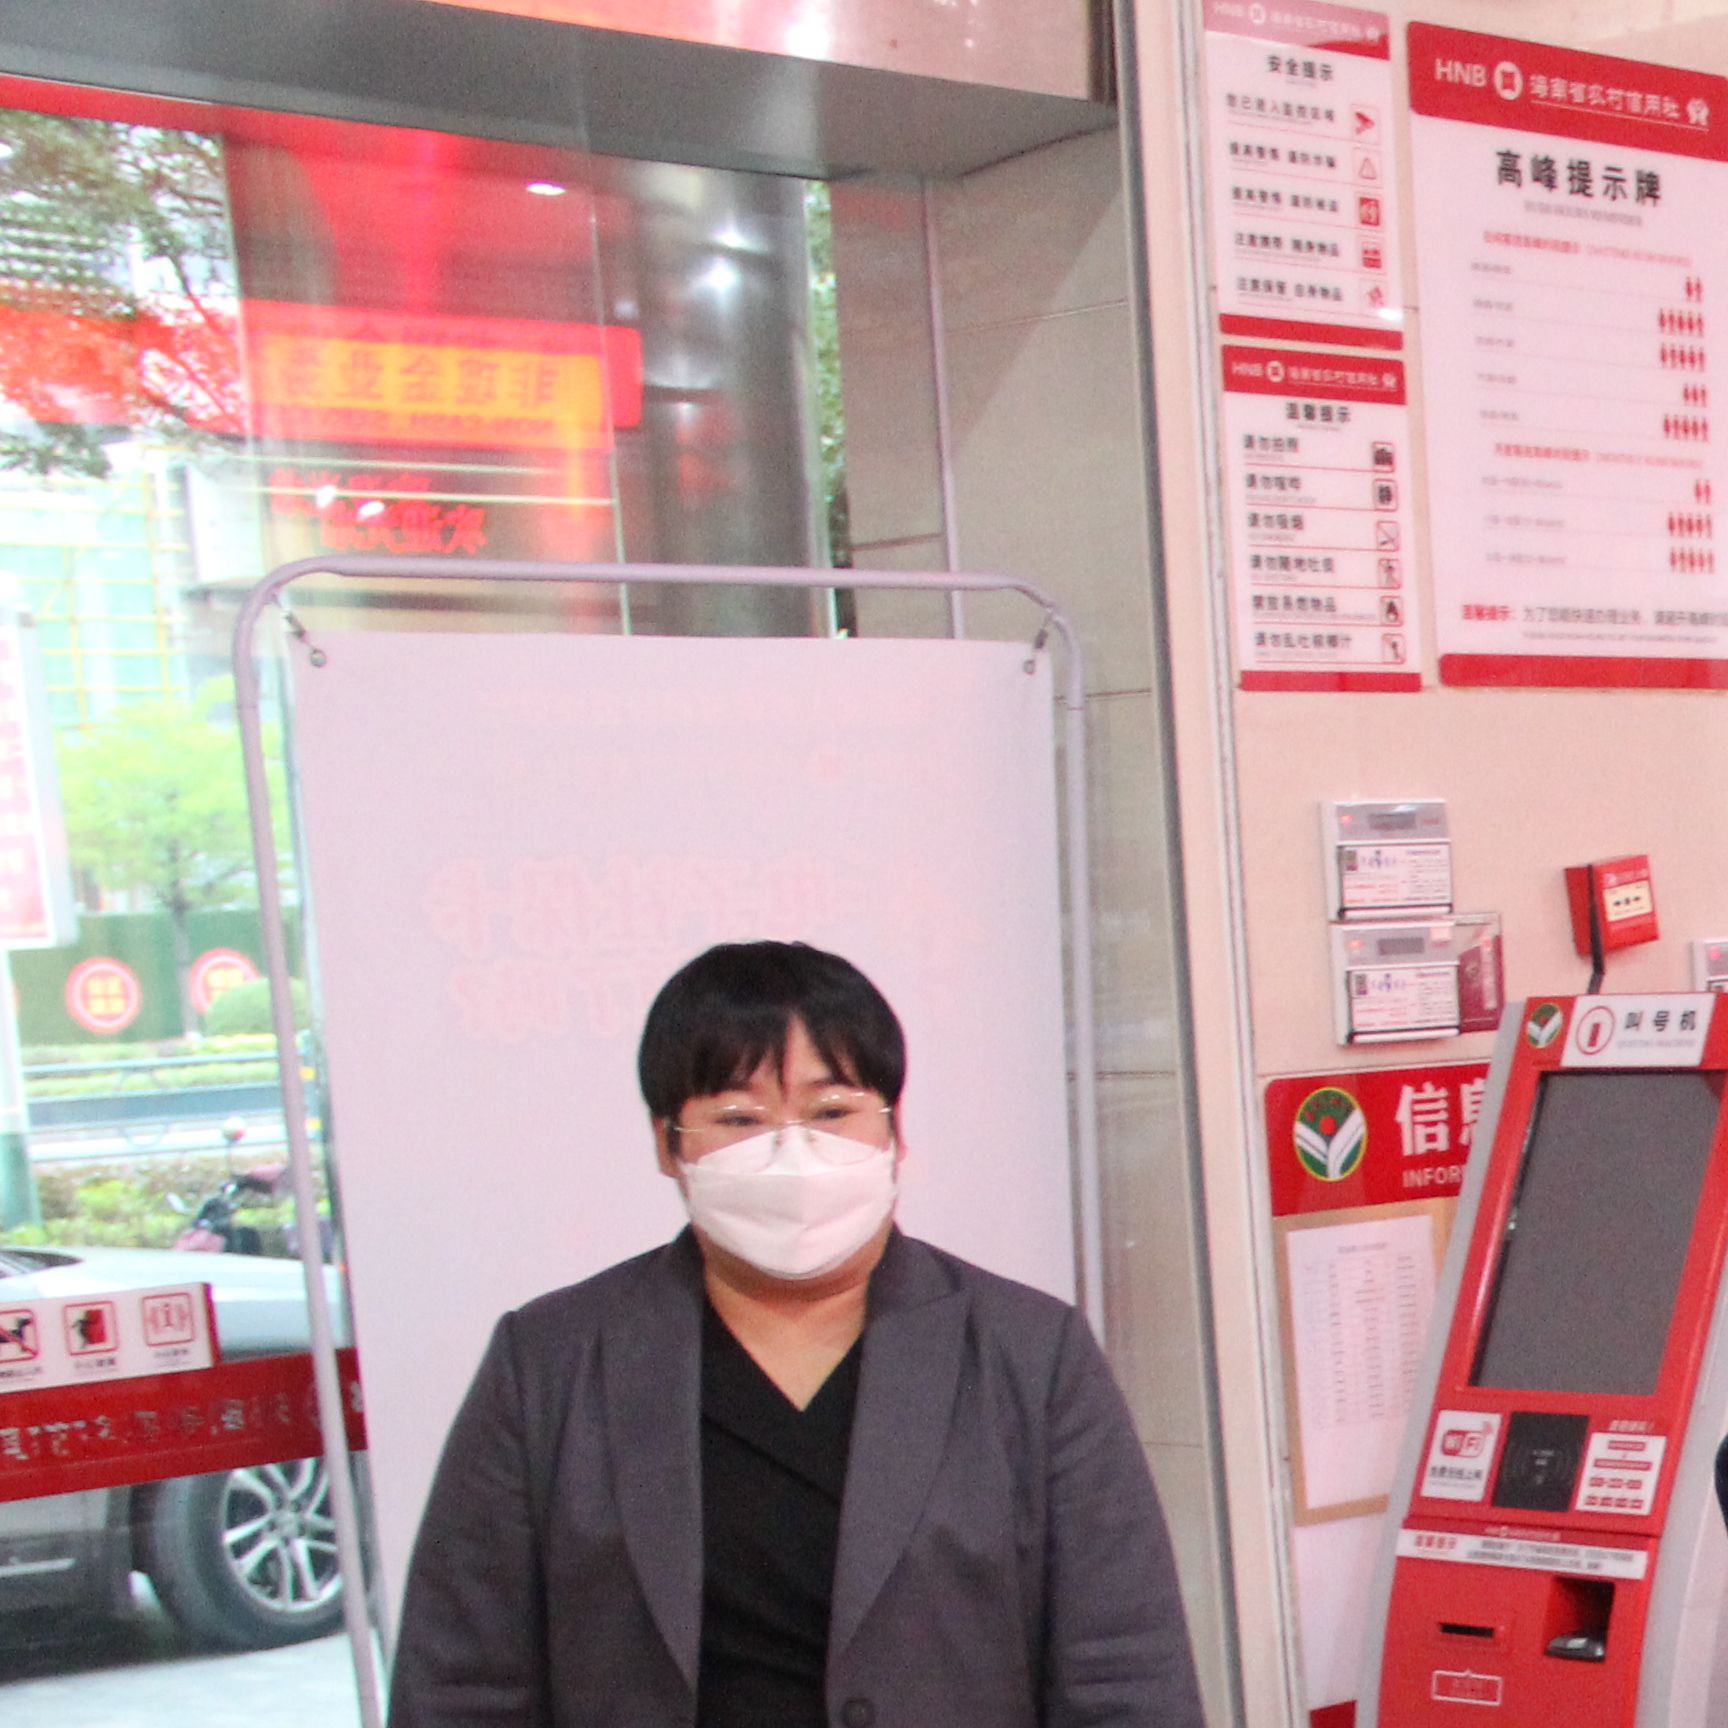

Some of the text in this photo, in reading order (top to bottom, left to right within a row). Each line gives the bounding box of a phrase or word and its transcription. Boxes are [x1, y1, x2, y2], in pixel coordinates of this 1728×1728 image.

[1267, 55, 1334, 81] 安全提示
[1435, 58, 1487, 88] HNB
[1496, 148, 1663, 208] 高峰提示牌
[1624, 1009, 1697, 1033] 叫号机
[1402, 1165, 1466, 1188] INFOR
